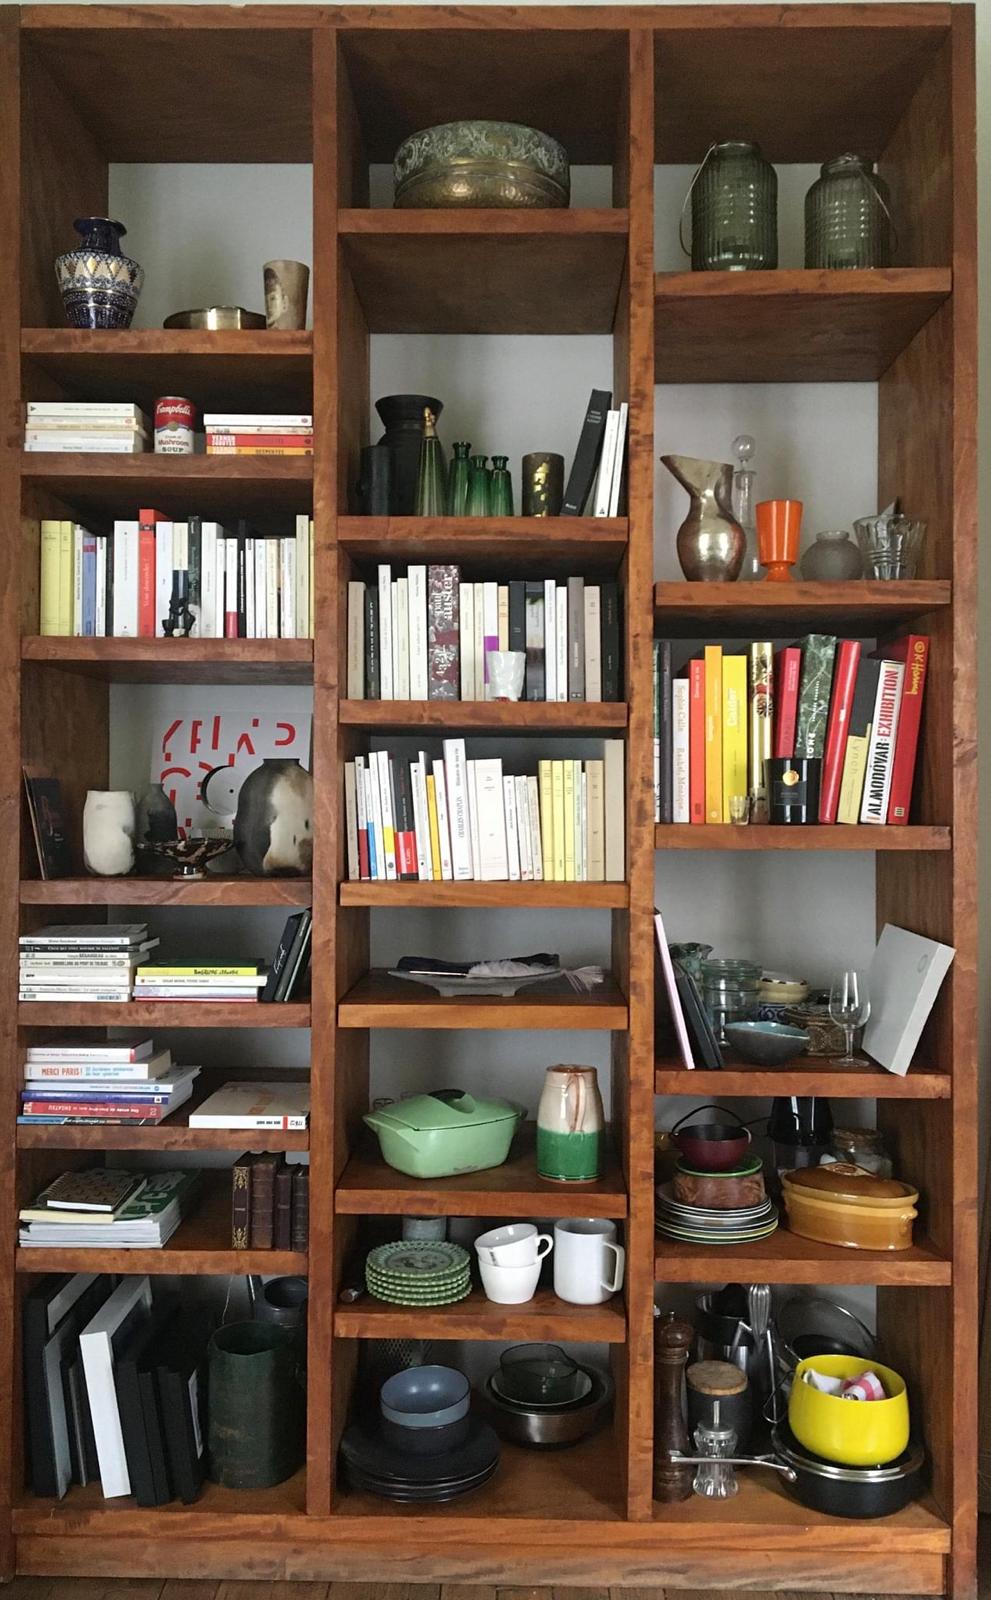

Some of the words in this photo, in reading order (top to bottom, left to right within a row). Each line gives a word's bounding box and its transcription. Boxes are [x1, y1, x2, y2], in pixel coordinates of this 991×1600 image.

[158, 439, 189, 447] Mushroom
[442, 574, 453, 620] auster
[727, 688, 737, 726] Calder
[877, 670, 899, 737] EXHIBITION
[41, 1068, 60, 1076] MERCI
[61, 1068, 80, 1076] PARIS
